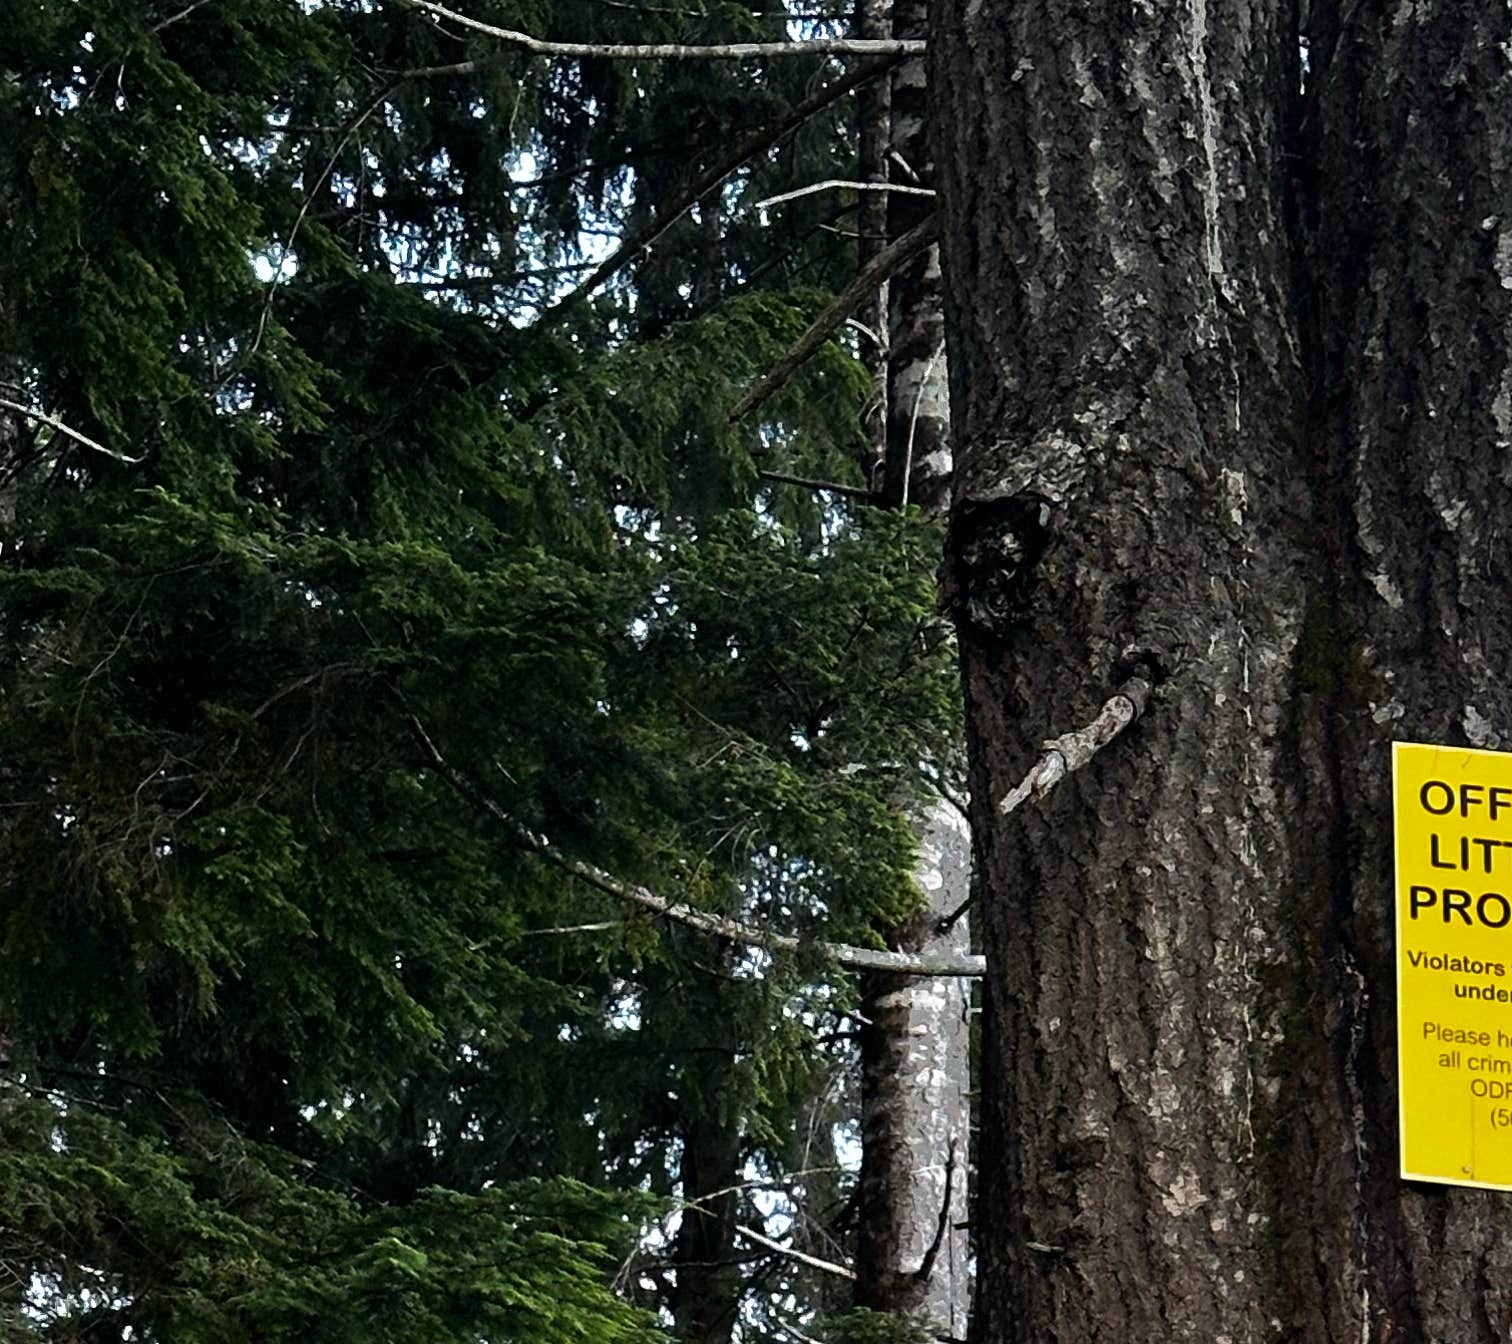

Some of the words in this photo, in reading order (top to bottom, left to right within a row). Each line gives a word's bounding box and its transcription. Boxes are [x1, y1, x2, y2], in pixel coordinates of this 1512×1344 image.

[1407, 950, 1505, 977] Violators
[1423, 1022, 1491, 1046] Please
[1438, 1051, 1460, 1070] all
